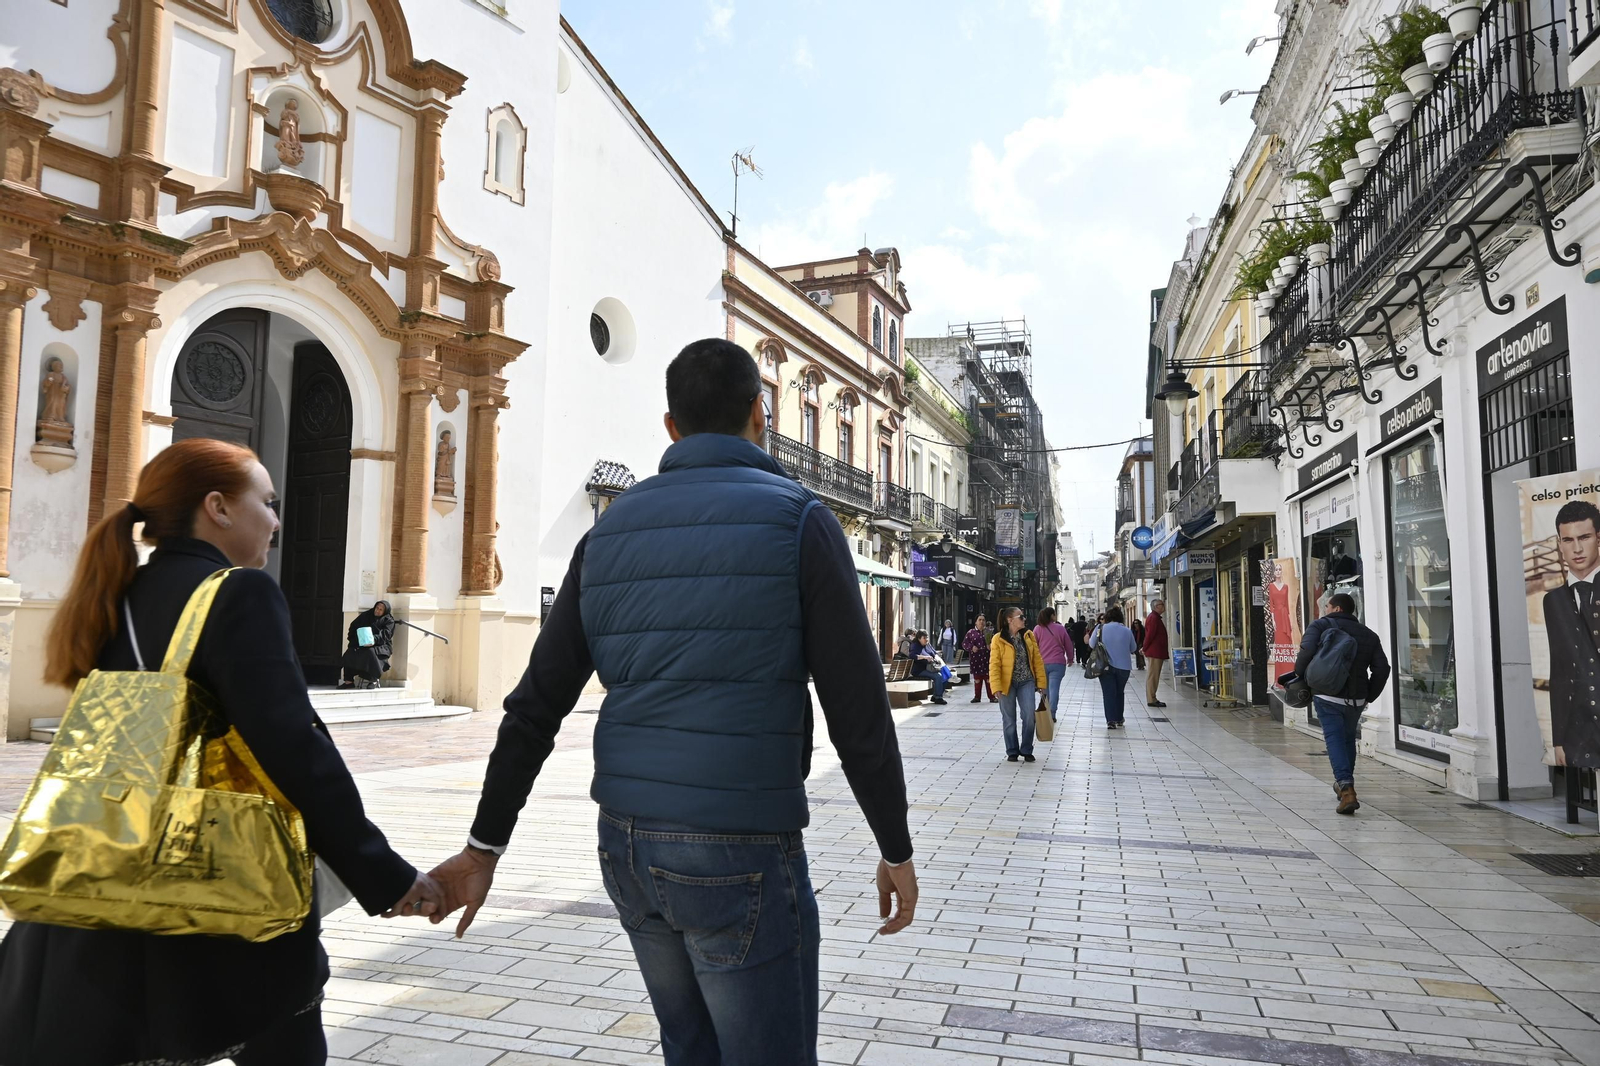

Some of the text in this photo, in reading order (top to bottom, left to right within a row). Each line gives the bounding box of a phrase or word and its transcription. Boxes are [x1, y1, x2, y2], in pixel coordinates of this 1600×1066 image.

[1488, 321, 1552, 375] artenovia
[1503, 359, 1532, 380] LOW COST
[1387, 390, 1433, 435] celso prieto
[1311, 452, 1343, 481] sara merino
[1531, 488, 1561, 501] celso
[1270, 648, 1290, 656] TRAJES
